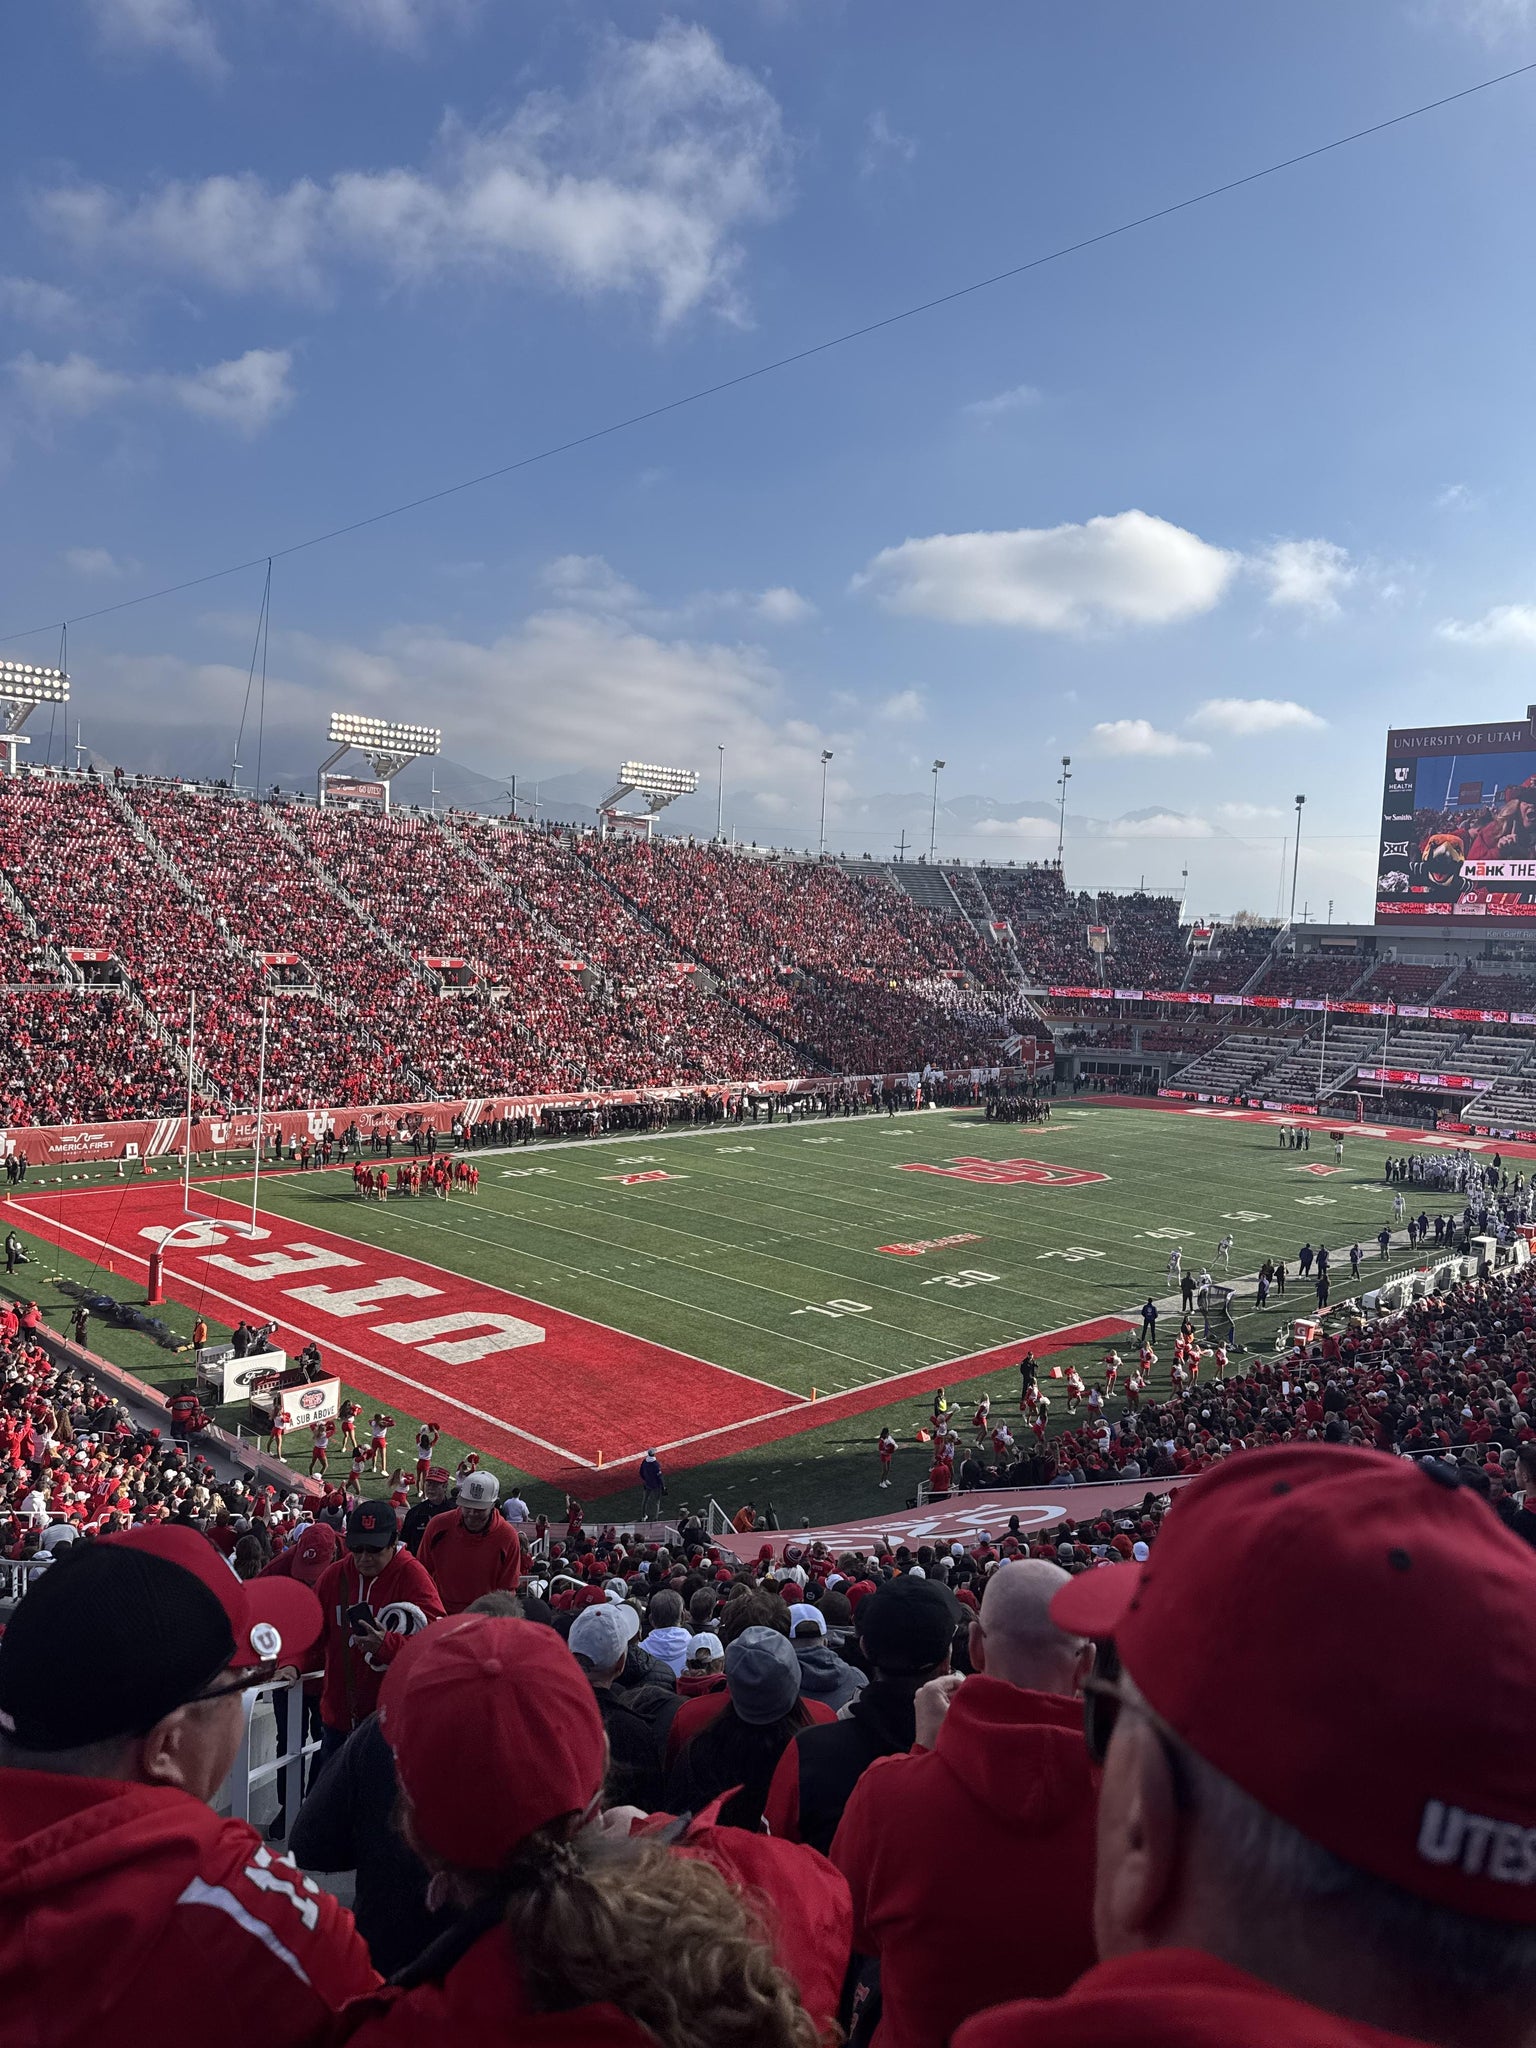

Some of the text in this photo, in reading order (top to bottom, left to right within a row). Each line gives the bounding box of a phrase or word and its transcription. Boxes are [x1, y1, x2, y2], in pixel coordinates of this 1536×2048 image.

[1394, 731, 1522, 749] UNIVERSITY OF UTAH
[358, 785, 367, 793] GO
[83, 952, 97, 961] 33
[275, 956, 287, 965] 34
[441, 960, 451, 968] 35
[1400, 1083, 1438, 1093] UTAH
[234, 1122, 282, 1136] HEALTH
[47, 1141, 115, 1153] AMERICA FIRST
[1219, 1210, 1273, 1222] 50
[1144, 1227, 1196, 1239] 40
[1043, 1246, 1107, 1262] 30
[931, 1269, 1001, 1289] 20
[805, 1298, 874, 1318] 10
[289, 1418, 294, 1427] A
[296, 1413, 311, 1425] SUB
[313, 1405, 335, 1421] ABOVE
[256, 1631, 275, 1649] U
